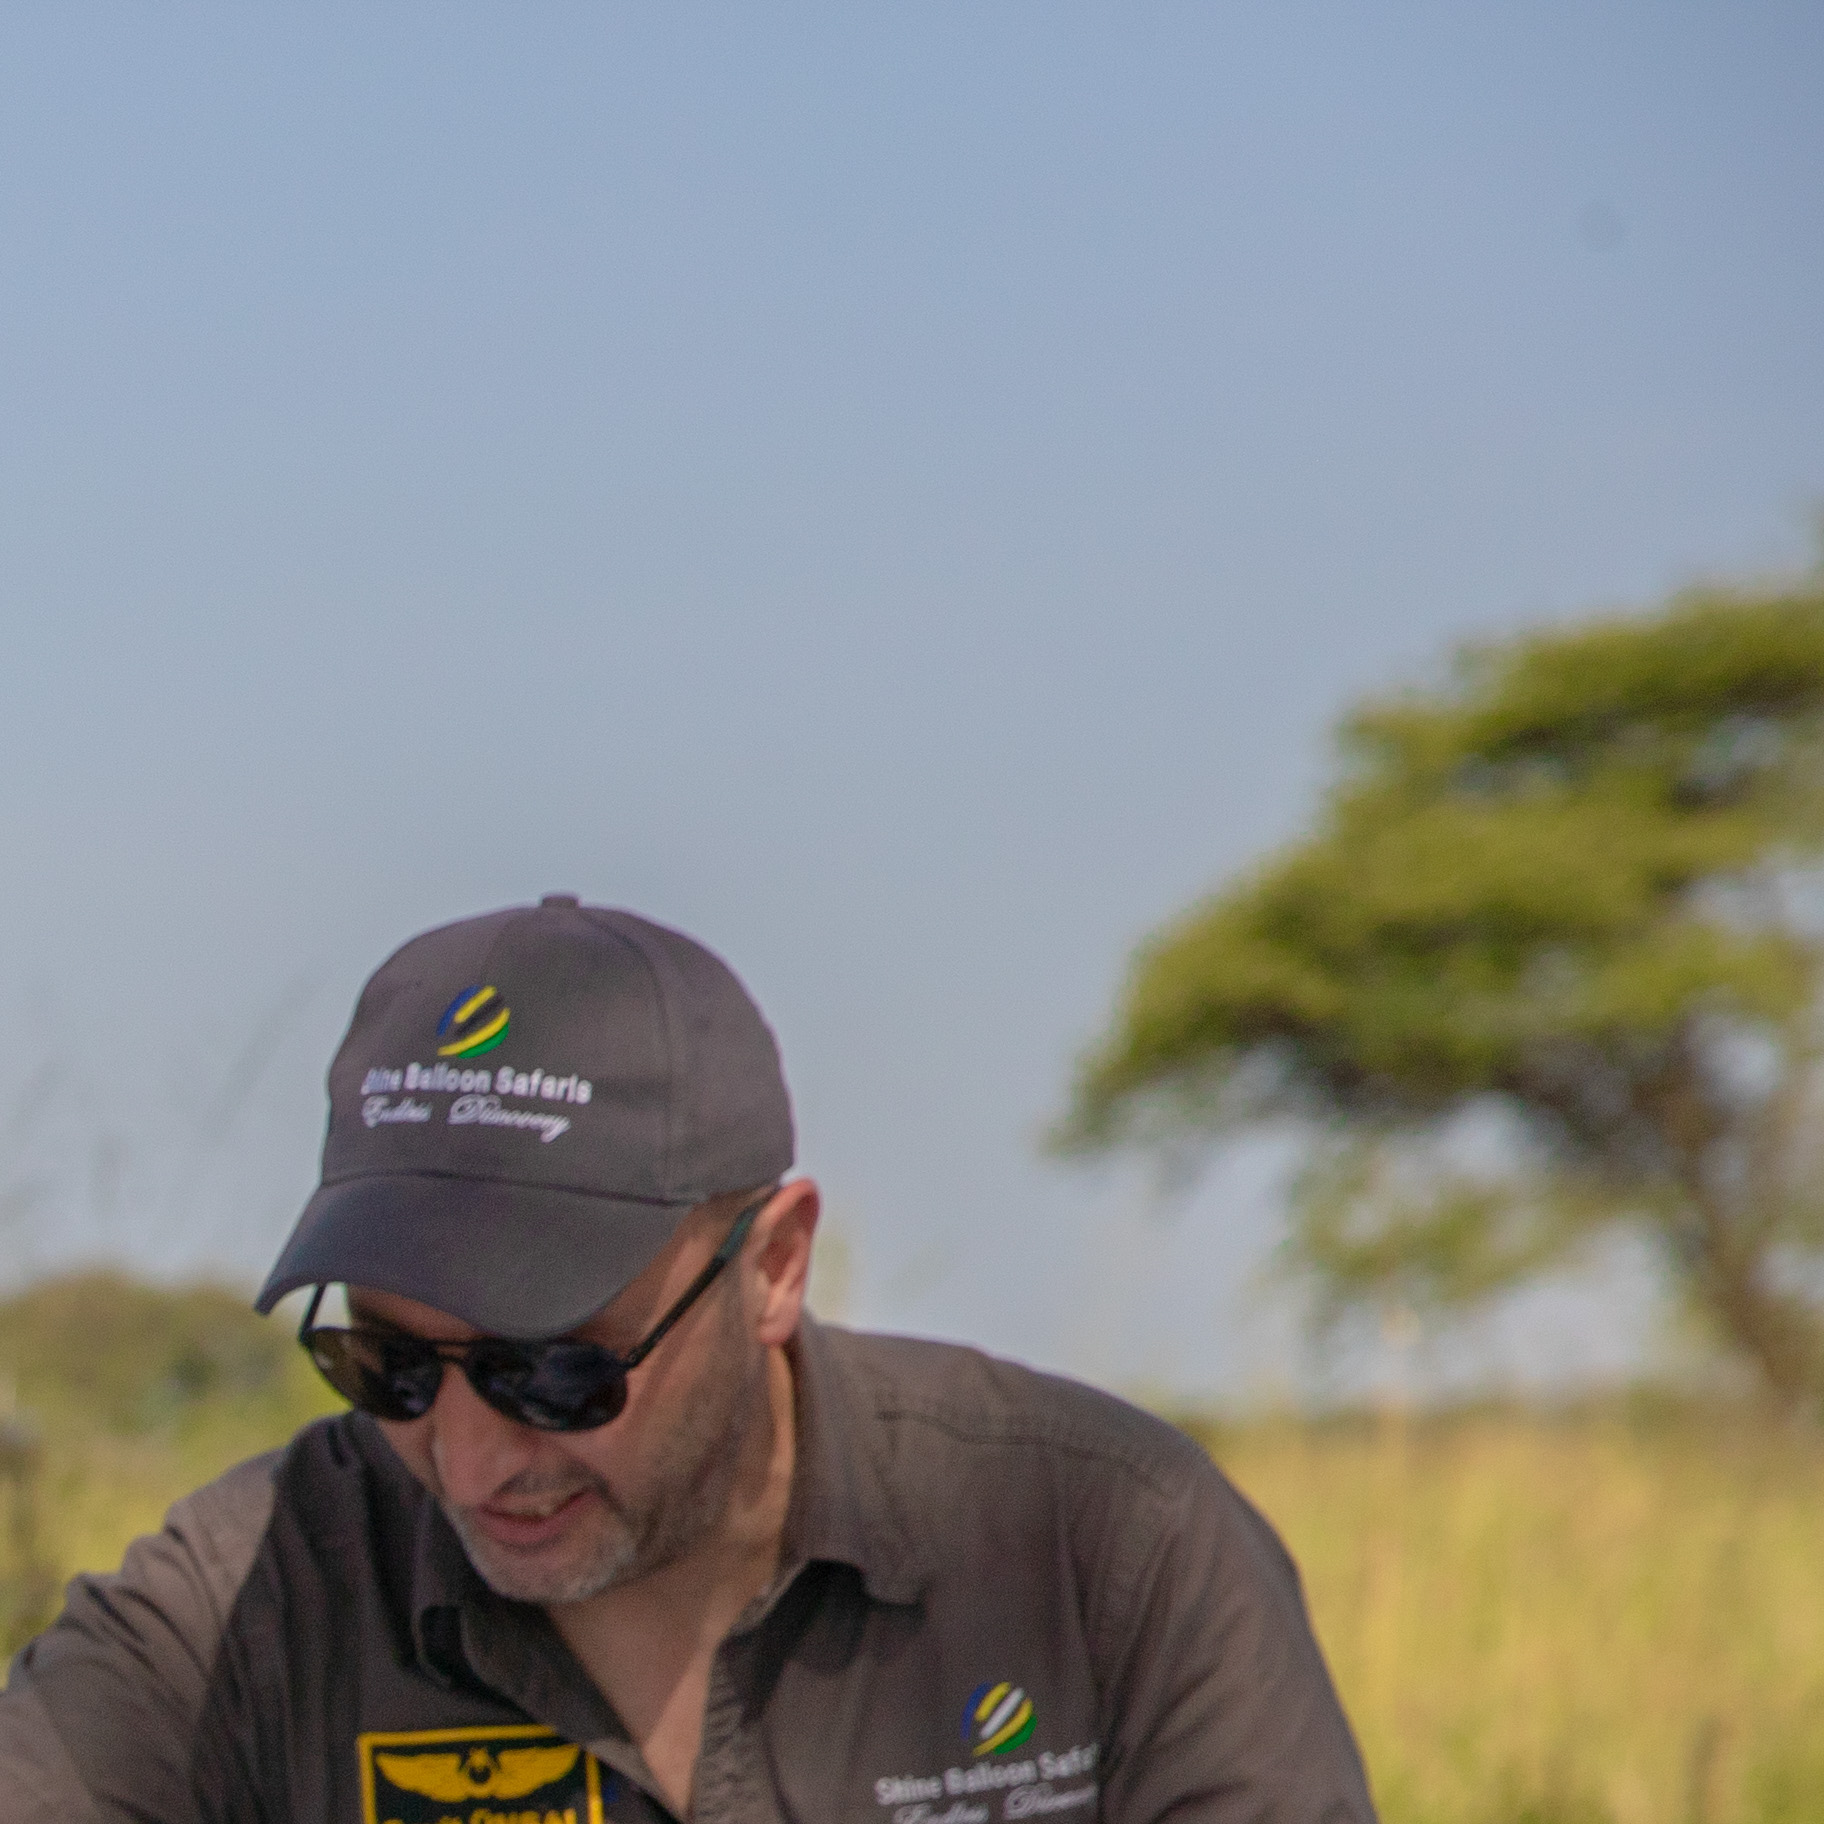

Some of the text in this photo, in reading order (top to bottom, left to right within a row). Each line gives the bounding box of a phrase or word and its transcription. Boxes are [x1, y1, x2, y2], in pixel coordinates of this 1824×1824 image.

[404, 1061, 492, 1094] Balloon
[495, 1065, 592, 1105] Safaris
[447, 1094, 571, 1144] Discovery
[875, 1774, 943, 1806] Shine
[943, 1760, 1039, 1795] Balloon
